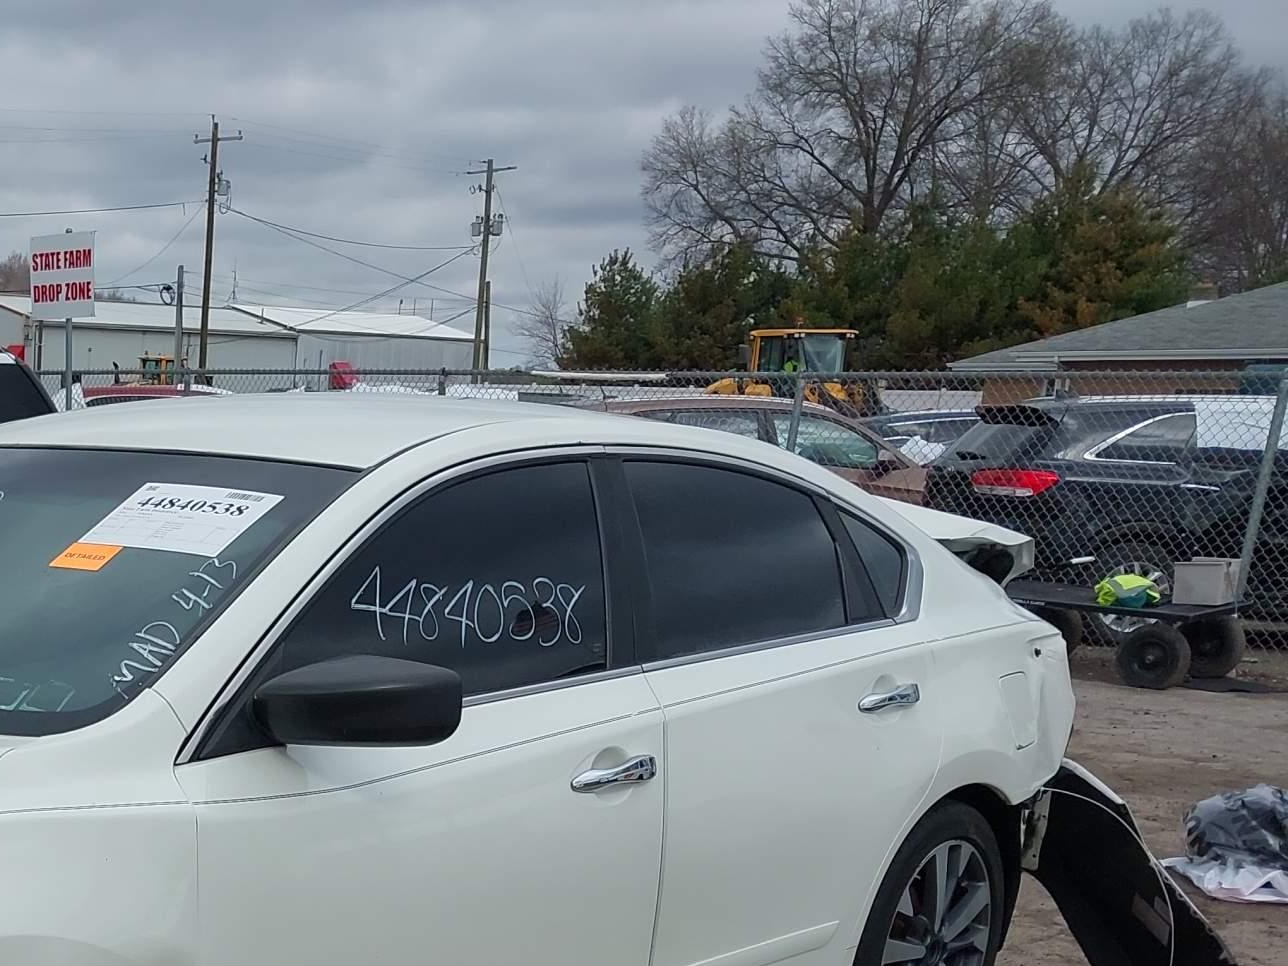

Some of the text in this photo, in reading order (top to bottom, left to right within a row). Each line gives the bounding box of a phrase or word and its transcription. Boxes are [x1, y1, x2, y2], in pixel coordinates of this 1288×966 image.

[32, 248, 92, 272] STATE FARM
[33, 281, 92, 304] DROP ZONE
[137, 496, 250, 517] 44840538
[64, 551, 107, 562] DETAILED
[351, 566, 586, 648] 44840538
